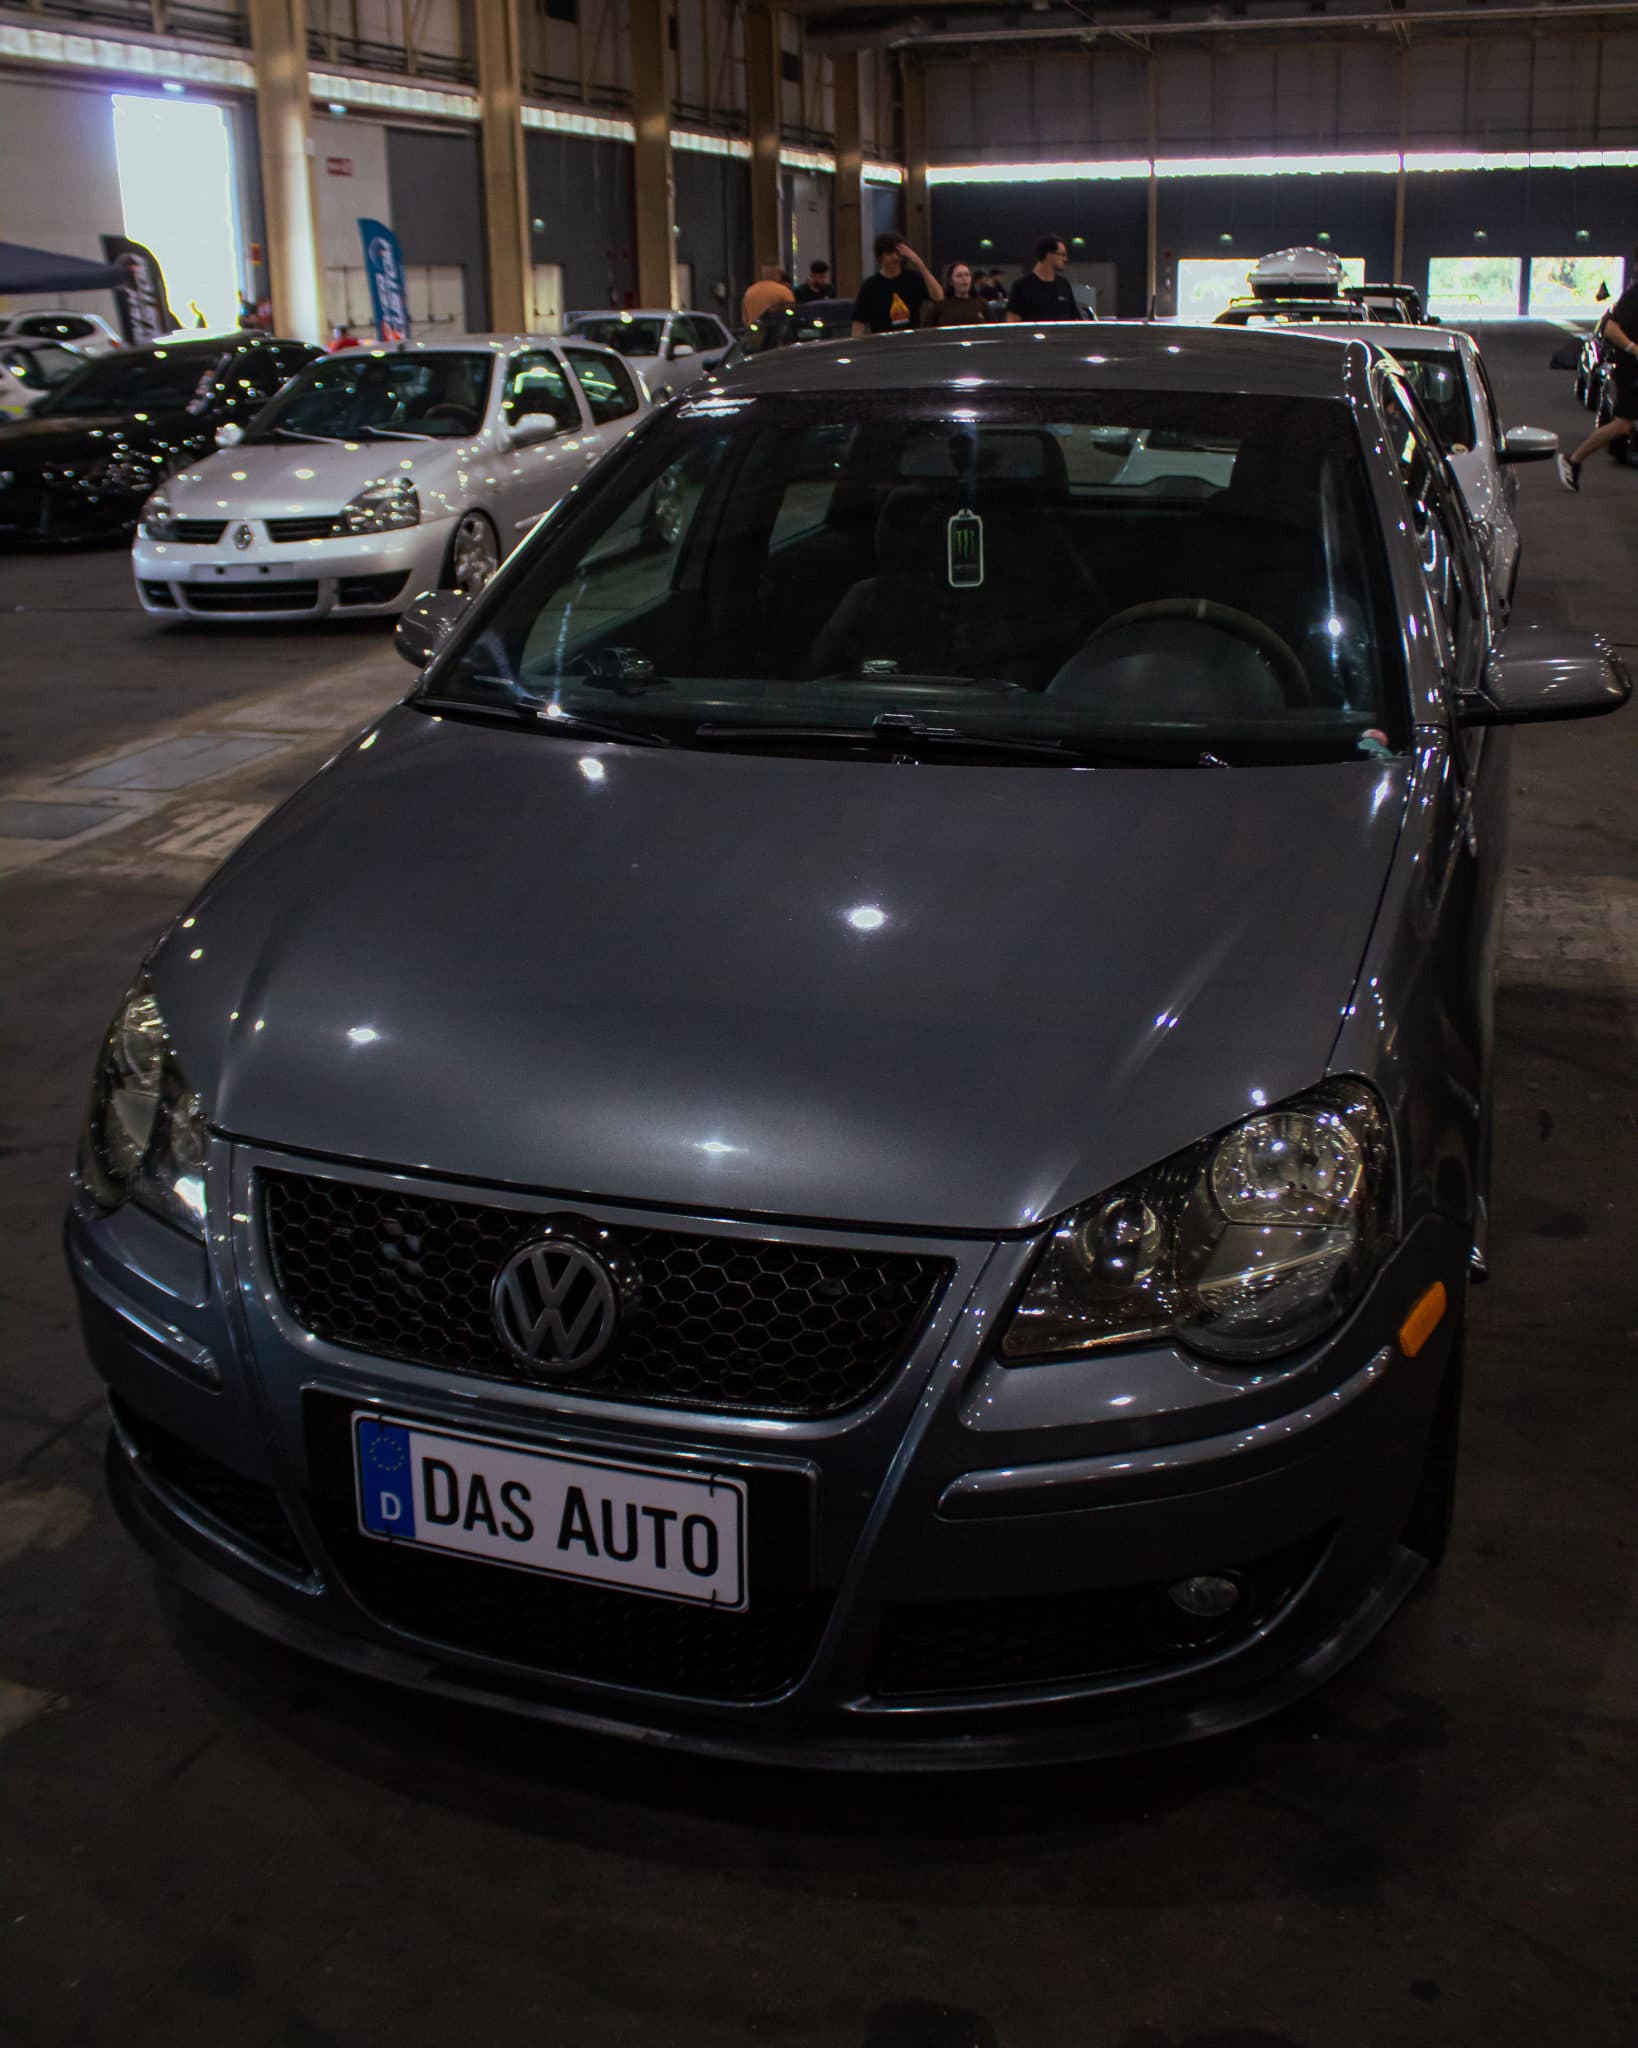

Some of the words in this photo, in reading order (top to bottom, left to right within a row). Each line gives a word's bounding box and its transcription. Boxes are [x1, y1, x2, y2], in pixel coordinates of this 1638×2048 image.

[380, 1491, 401, 1521] D
[422, 1457, 534, 1542] DAS
[557, 1486, 719, 1577] AUTO
